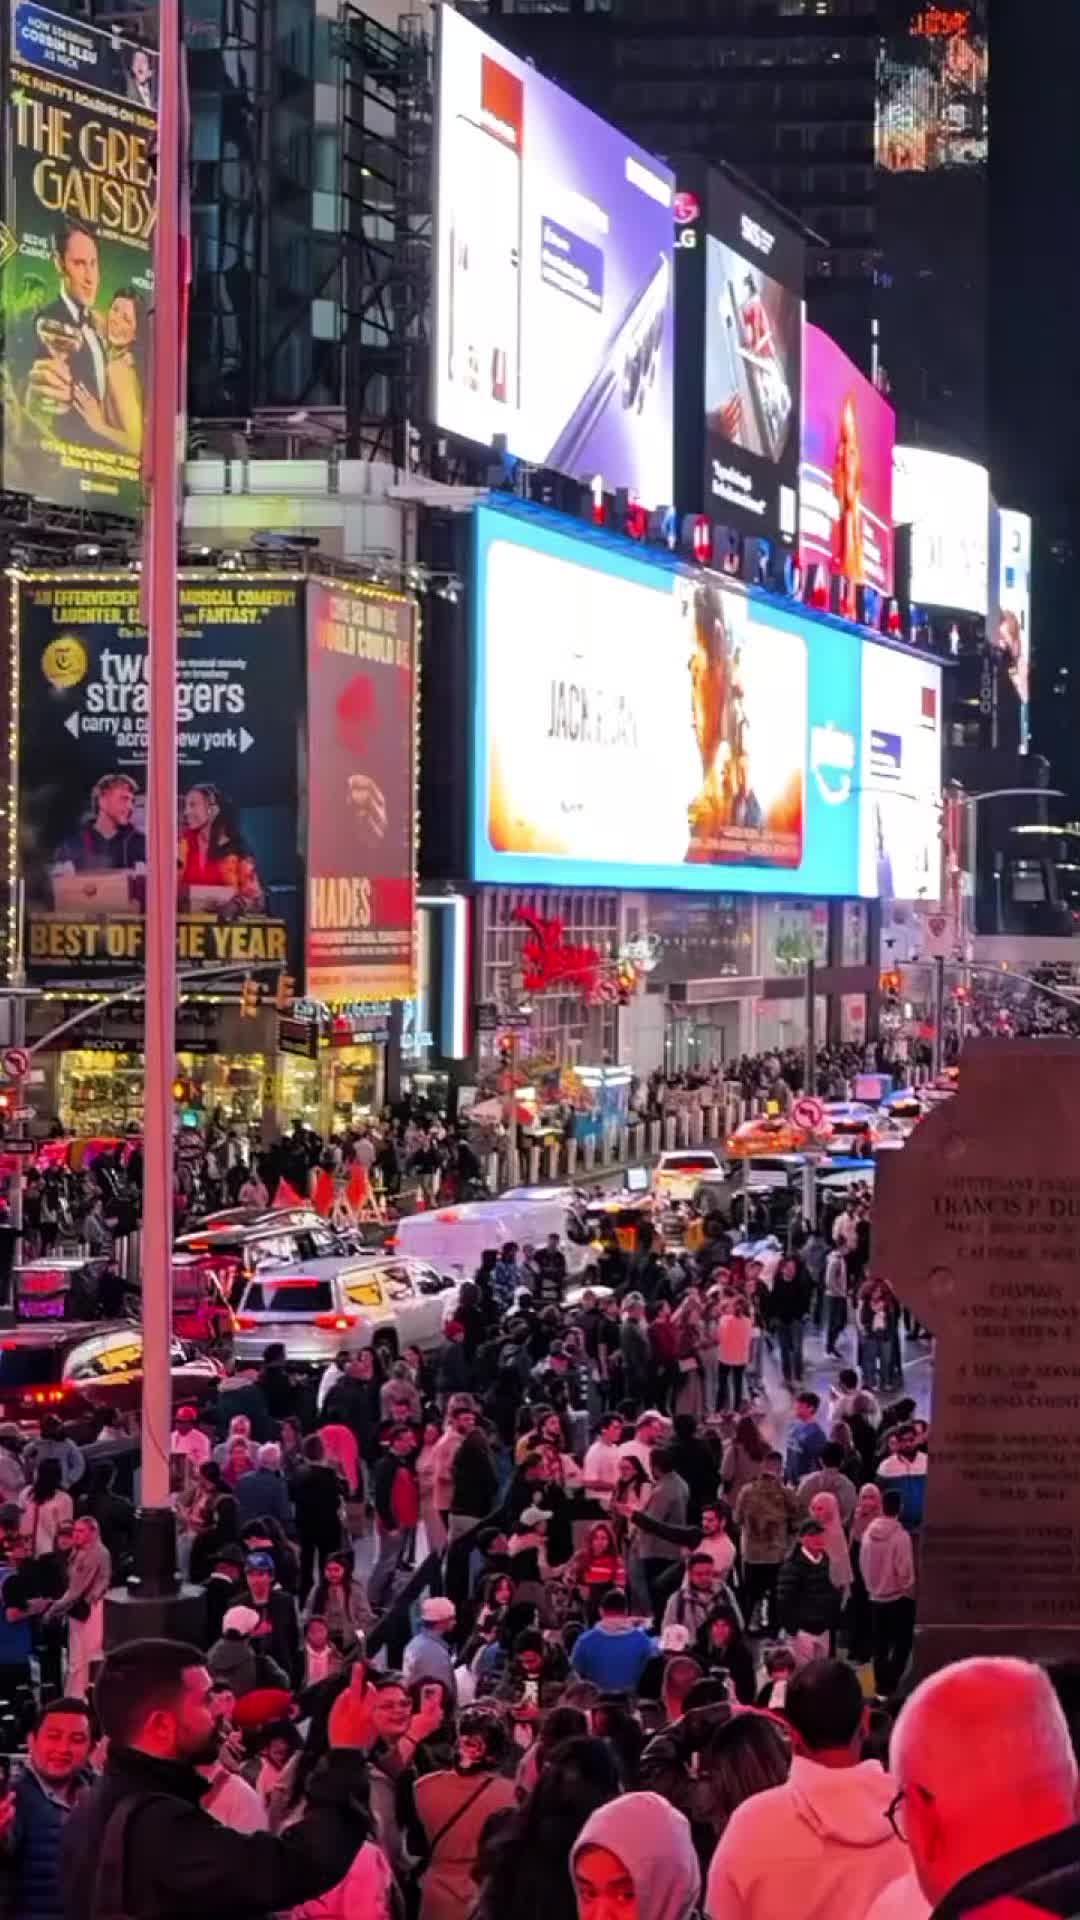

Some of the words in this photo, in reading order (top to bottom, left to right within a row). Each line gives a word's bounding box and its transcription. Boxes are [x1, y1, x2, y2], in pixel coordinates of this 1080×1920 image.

[17, 97, 73, 162] THE
[79, 120, 157, 188] GRE
[33, 159, 158, 239] GATSBY
[54, 589, 140, 606] EFFERVESCEN
[86, 682, 245, 722] stragers
[81, 716, 120, 737] carry
[123, 718, 133, 732] a
[202, 729, 237, 754] york
[311, 876, 371, 929] HADES
[31, 924, 99, 956] BEST
[107, 925, 144, 957] OF
[177, 927, 203, 957] HE
[213, 927, 287, 961] YEAR
